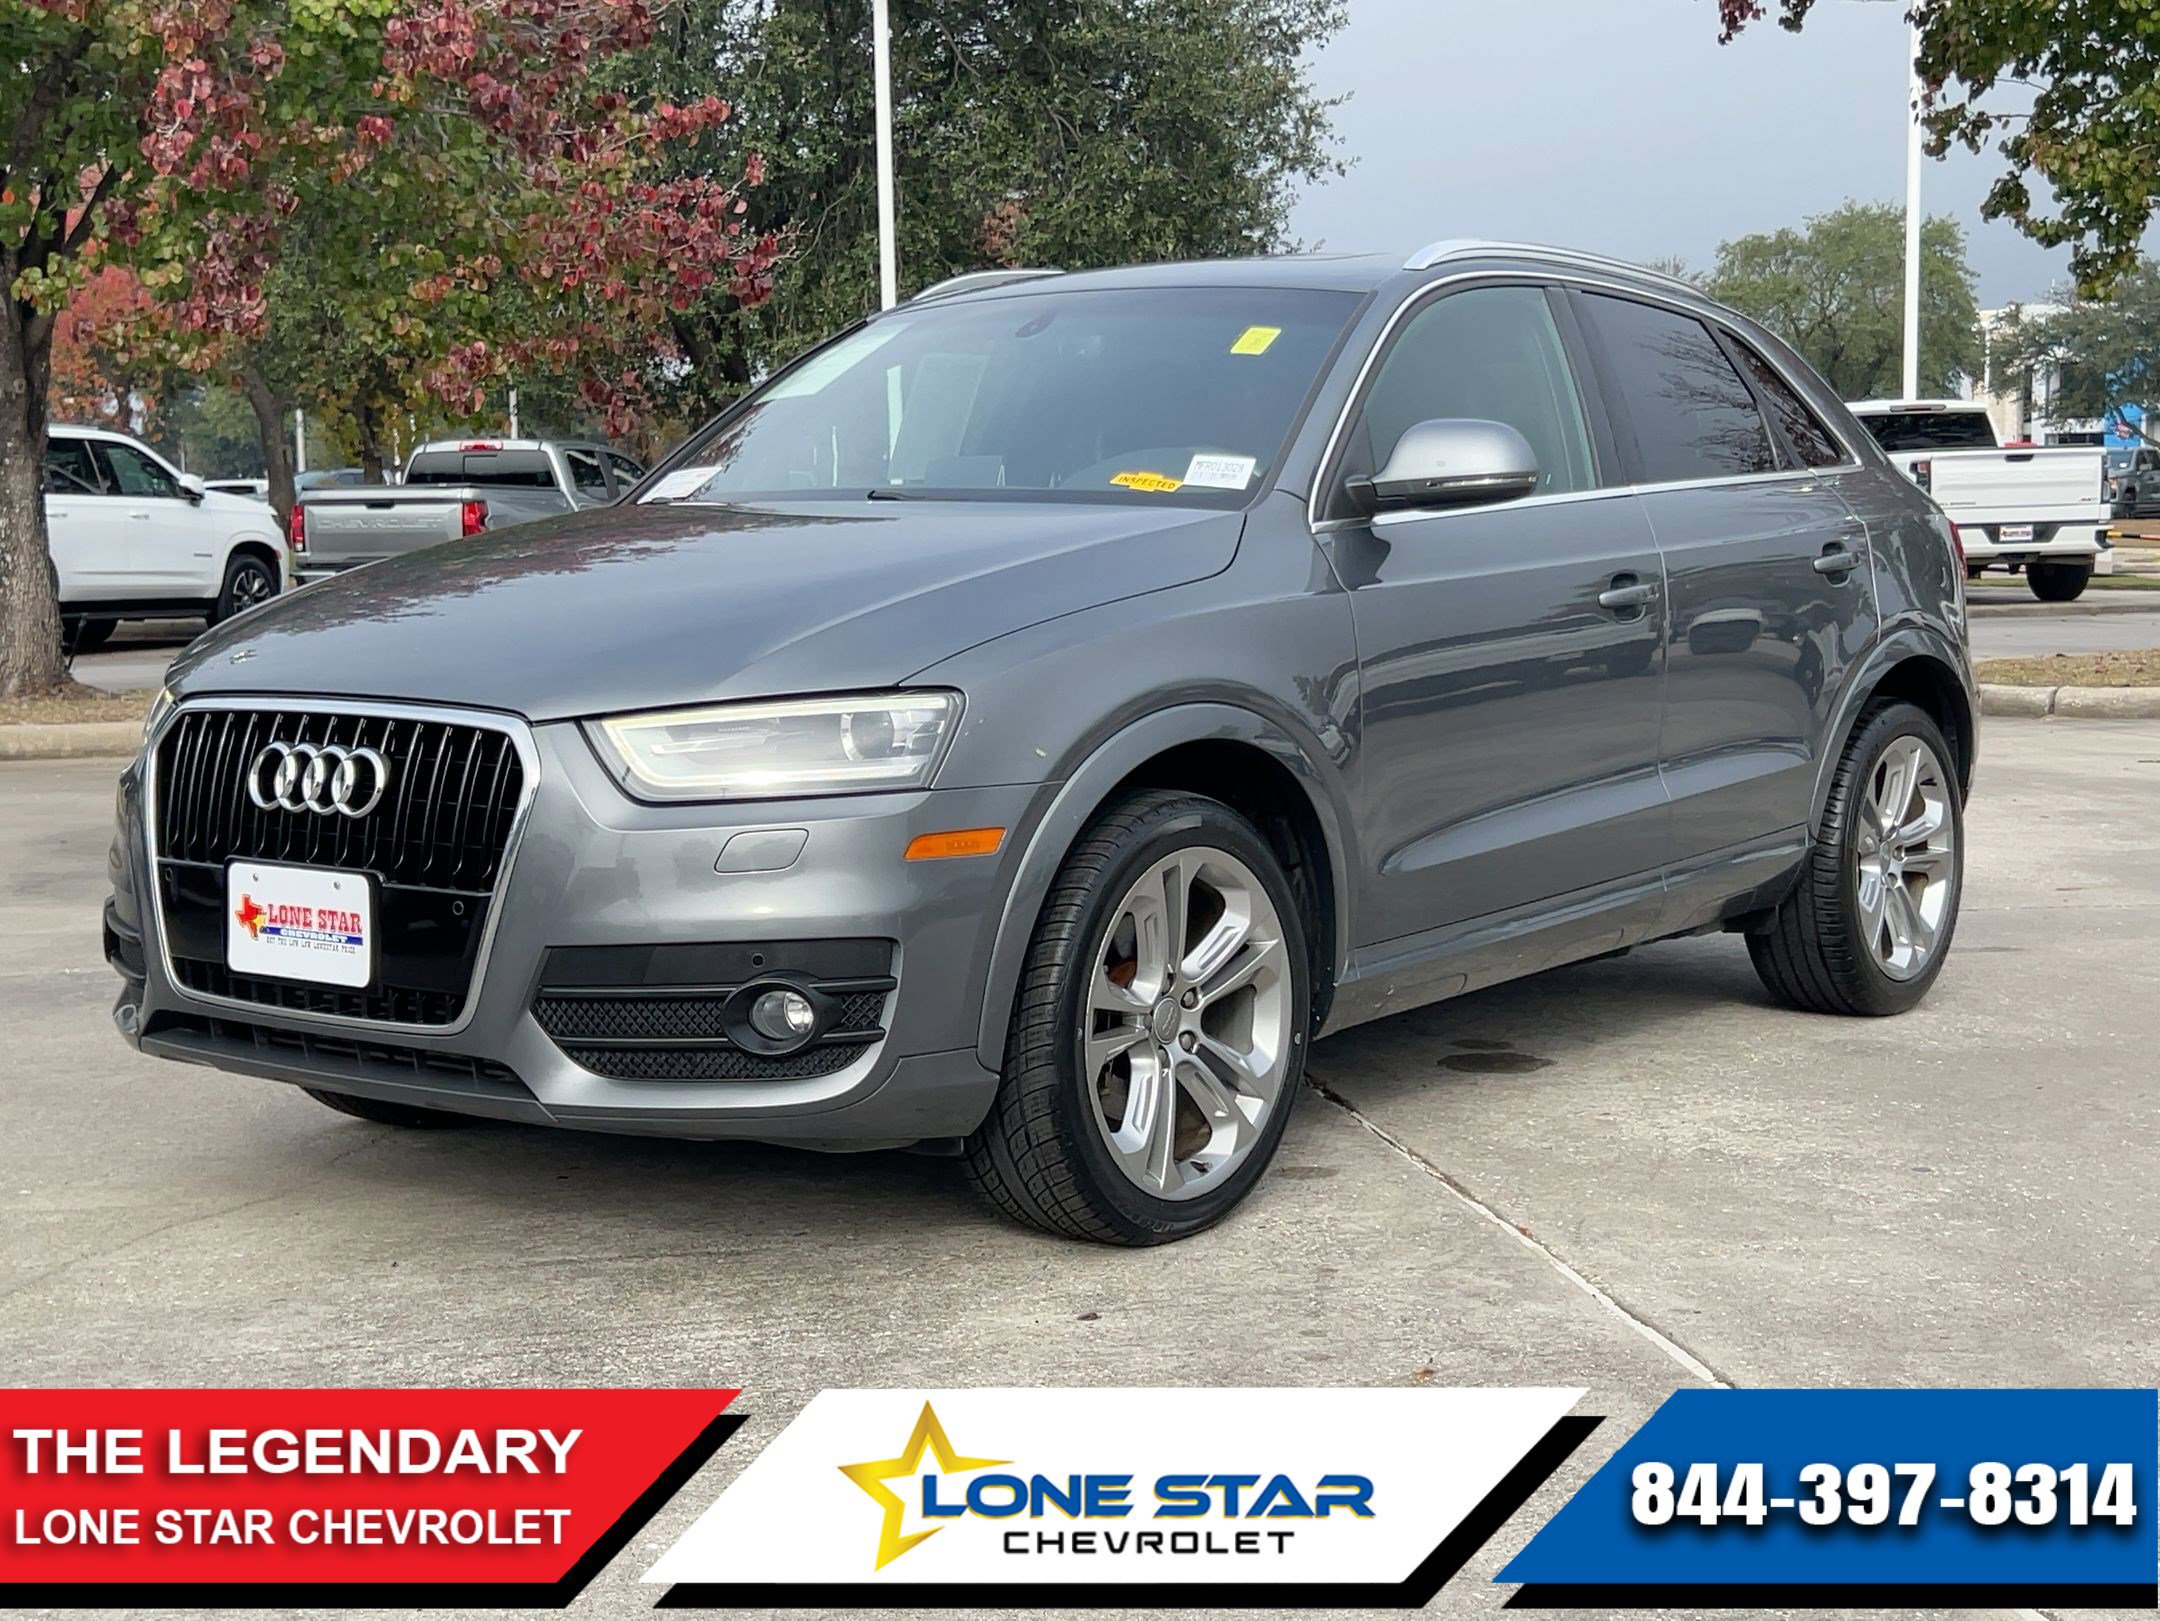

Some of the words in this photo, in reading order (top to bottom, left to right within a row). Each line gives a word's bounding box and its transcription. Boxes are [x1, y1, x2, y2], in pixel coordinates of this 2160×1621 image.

[1118, 476, 1176, 489] INSPECTED
[318, 517, 444, 529] CHEVROLET
[268, 904, 312, 927] LONE
[318, 909, 362, 933] STAR
[280, 928, 347, 942] CHEVROLET
